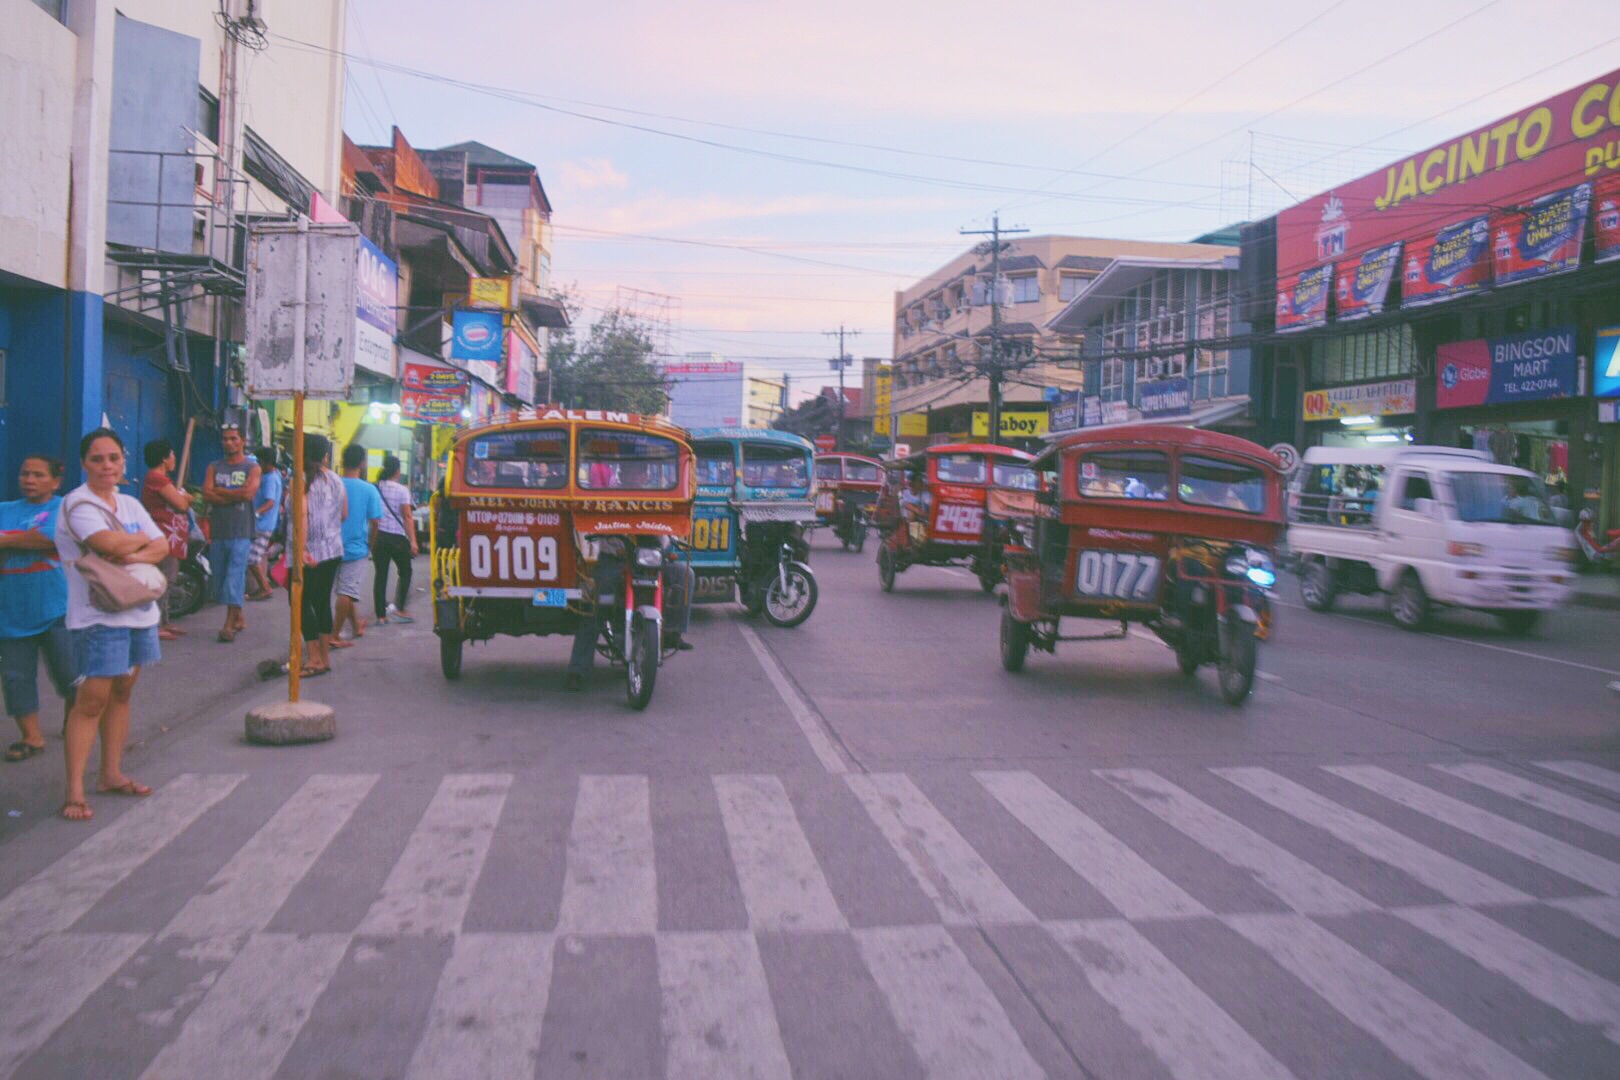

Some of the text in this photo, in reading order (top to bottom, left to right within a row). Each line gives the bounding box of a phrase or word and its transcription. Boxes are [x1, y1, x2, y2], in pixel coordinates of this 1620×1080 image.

[1375, 107, 1553, 212] JACINTO
[1321, 230, 1344, 258] TM
[1495, 334, 1571, 363] BINGSON
[1513, 358, 1550, 378] MART
[582, 500, 673, 512] FRANCIS
[470, 534, 559, 581] 0109
[1077, 550, 1160, 599] 0177
